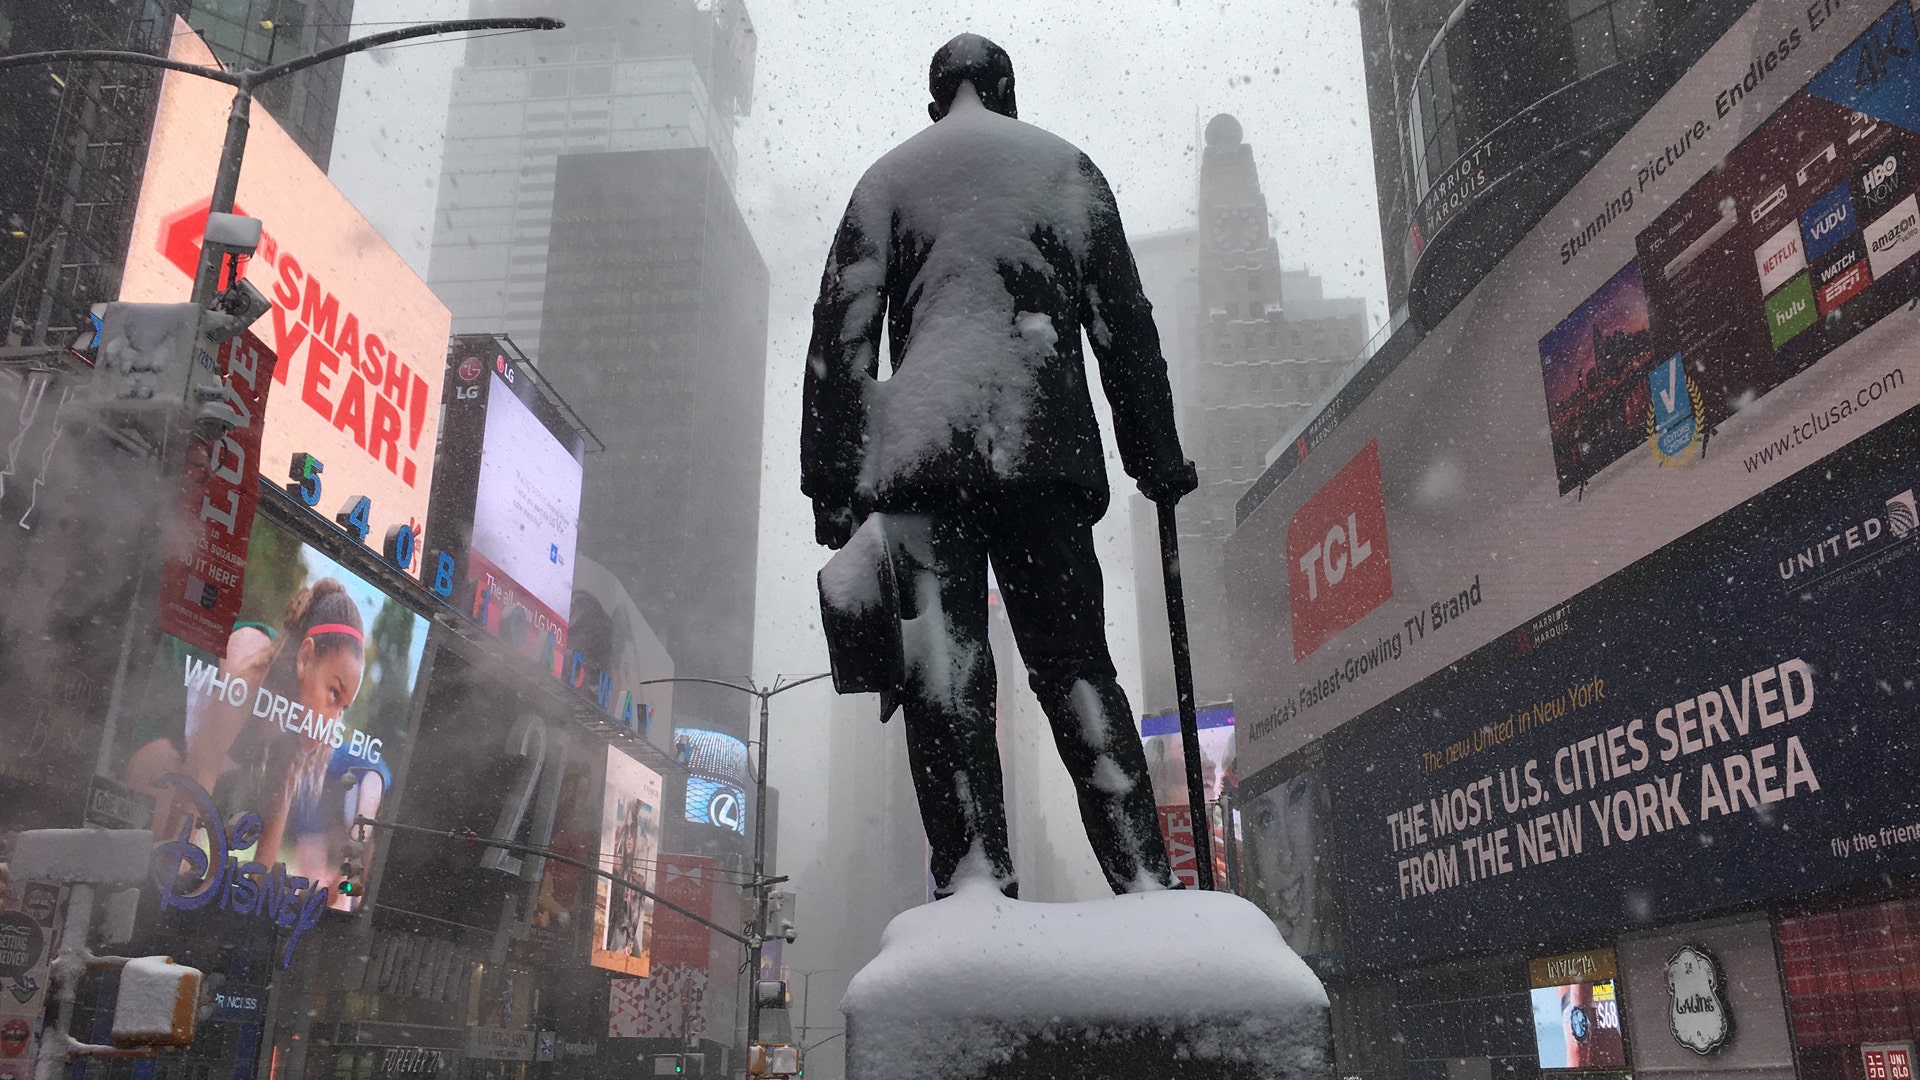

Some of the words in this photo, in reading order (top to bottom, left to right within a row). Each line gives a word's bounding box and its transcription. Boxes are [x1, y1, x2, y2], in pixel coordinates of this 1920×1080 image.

[1560, 186, 1634, 266] Stunning
[1638, 117, 1712, 193] Picture.
[1715, 27, 1802, 121] Endless
[1425, 141, 1493, 214] MARRIOTT
[1862, 155, 1897, 194] HBO
[1866, 173, 1900, 209] NOW
[1427, 170, 1486, 234] MARQUIS
[1810, 204, 1847, 240] VUDU
[1871, 214, 1916, 253] amazon
[1901, 227, 1919, 245] video
[1762, 239, 1798, 276] NETFLIX
[1820, 250, 1856, 282] WATCH
[1825, 267, 1860, 303] ESPN
[1776, 298, 1806, 326] hulu
[504, 363, 515, 383] LG
[456, 385, 480, 400] LG
[201, 334, 259, 535] LOVE
[1743, 368, 1905, 473] www.tclusa.com
[1299, 512, 1372, 602] TCL
[1779, 517, 1882, 580] UNITED
[195, 558, 207, 573] IT
[208, 563, 238, 588] HERE
[534, 610, 545, 632] LG
[1532, 605, 1571, 633] MARRIOTT
[1533, 620, 1569, 648] MARQUIS
[434, 549, 657, 742] BROADWAY
[1248, 696, 1297, 745] America's
[1299, 631, 1402, 714] Fastest-Growing
[1404, 610, 1426, 647] TV
[1430, 574, 1482, 632] Brand
[184, 654, 248, 708] WHO
[252, 686, 346, 749] DREAMS
[348, 729, 383, 765] BIG
[1423, 749, 1443, 774] The
[1445, 735, 1470, 764] new
[1473, 713, 1515, 752] United
[1517, 708, 1531, 733] in
[1533, 695, 1566, 729] New
[1568, 674, 1606, 711] York
[1387, 803, 1428, 852] THE
[1430, 776, 1494, 838] MOST
[1499, 759, 1550, 814] U.S.
[1554, 719, 1649, 795] CITIES
[1655, 658, 1815, 761] SERVED
[1398, 844, 1460, 901] FROM
[1462, 827, 1513, 882] THE
[1516, 804, 1583, 868] NEW
[1589, 772, 1691, 847] YORK
[1700, 735, 1821, 821] AREA
[1831, 837, 1850, 859] fly
[1852, 832, 1878, 854] the
[1547, 955, 1597, 979] INVICTA
[1598, 1001, 1618, 1029] $68
[380, 1048, 429, 1073] FOREVER
[1889, 1054, 1906, 1065] UNI
[1892, 1066, 1909, 1079] QLO
